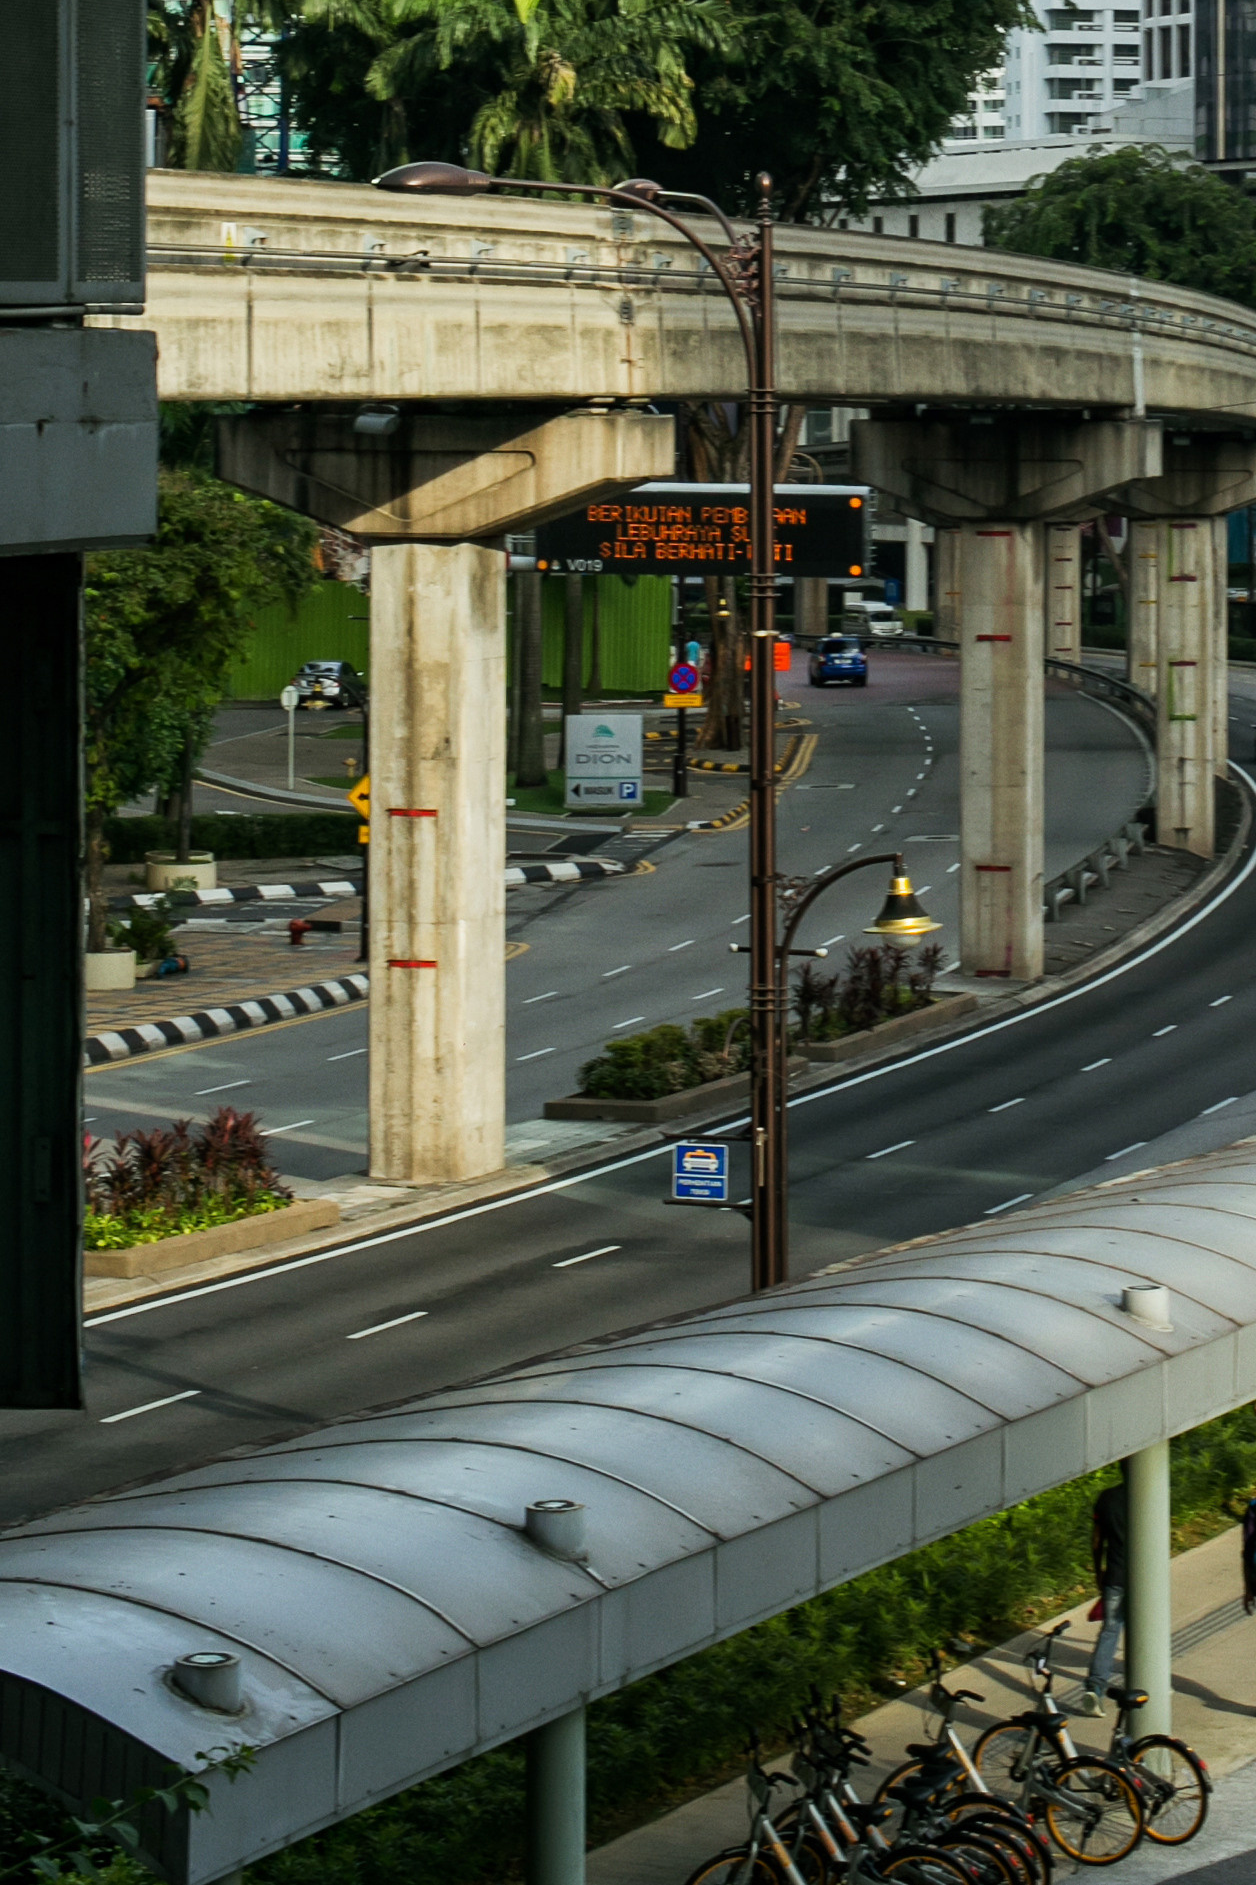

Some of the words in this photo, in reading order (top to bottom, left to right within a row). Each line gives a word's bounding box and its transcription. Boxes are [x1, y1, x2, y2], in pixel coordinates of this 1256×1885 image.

[586, 504, 693, 523] BERIKUTAN
[701, 505, 807, 525] PEMBAAN
[616, 523, 722, 542] LEBUHRAYA
[598, 541, 647, 559] SILA
[655, 542, 794, 562] BERHATI-TI
[566, 558, 603, 572] V019
[575, 753, 632, 765] DION
[622, 783, 635, 798] P
